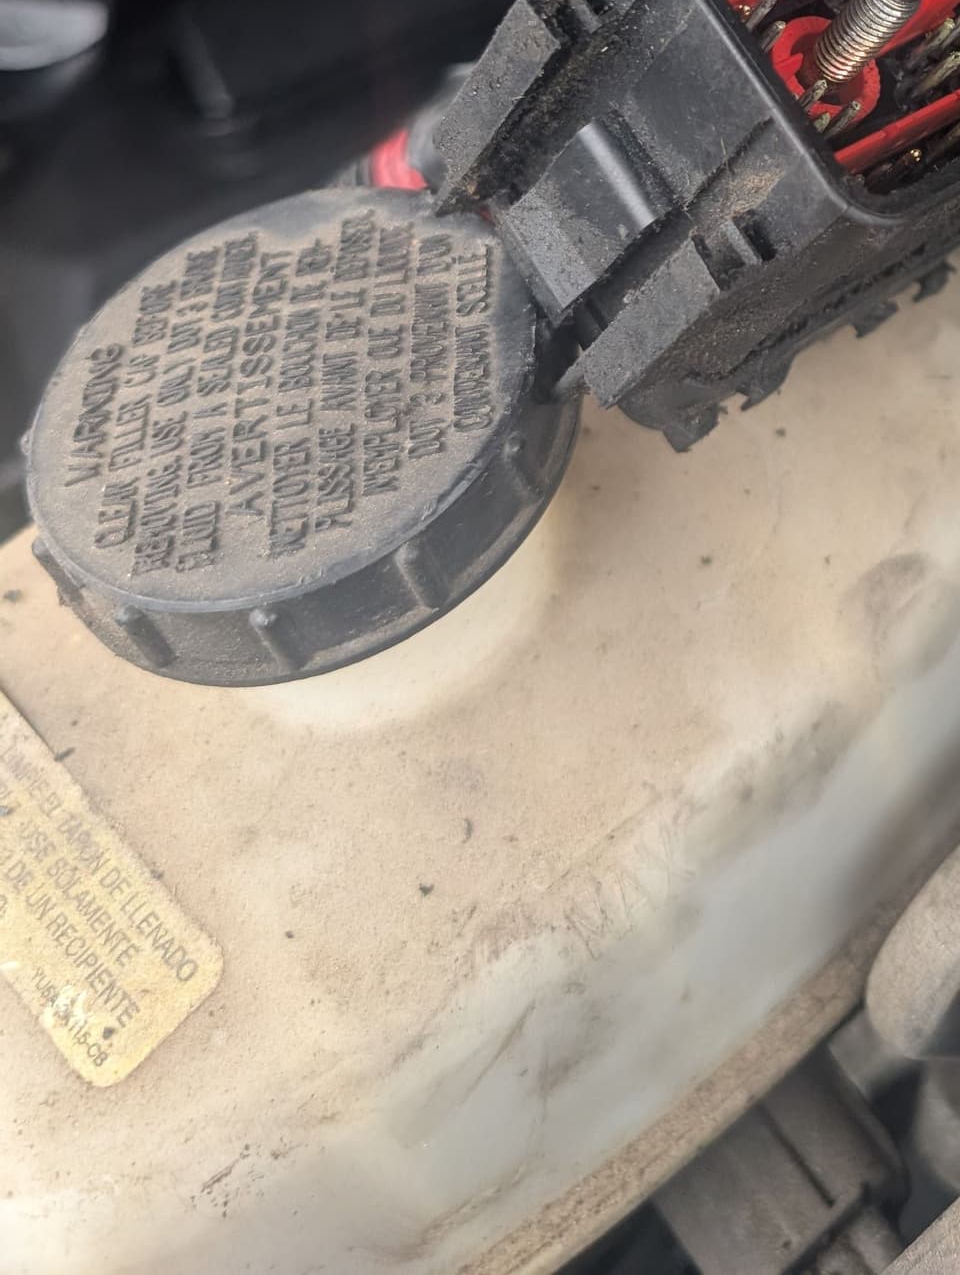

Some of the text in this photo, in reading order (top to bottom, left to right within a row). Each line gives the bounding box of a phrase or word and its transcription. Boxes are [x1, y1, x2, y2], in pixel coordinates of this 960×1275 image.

[134, 284, 175, 345] BEFORE
[176, 300, 207, 315] 3
[370, 292, 404, 317] DU
[409, 282, 449, 381] PROVENANT
[166, 317, 203, 353] DOT
[196, 324, 239, 396] SEALED
[277, 308, 321, 392] BOUCHON
[366, 324, 402, 359] QUE
[123, 355, 160, 387] CAP
[156, 358, 195, 405] ONLY
[224, 250, 291, 515] AVERTISSEMENT
[318, 351, 357, 411] AVANT
[409, 392, 442, 405] 3
[63, 343, 122, 486] WARNING
[109, 395, 151, 470] FILLER
[149, 411, 187, 457] USE
[192, 402, 227, 418] A
[276, 398, 312, 430] LE
[407, 418, 443, 458] DOT
[185, 426, 225, 488] FROM
[314, 423, 353, 532] PLISSAGE
[268, 436, 309, 554] NETTOYER
[1, 858, 37, 895] DE
[22, 884, 58, 921] UN
[43, 912, 142, 1028] RECIPIENTE
[96, 865, 131, 900] DE
[118, 893, 199, 984] LLENADO
